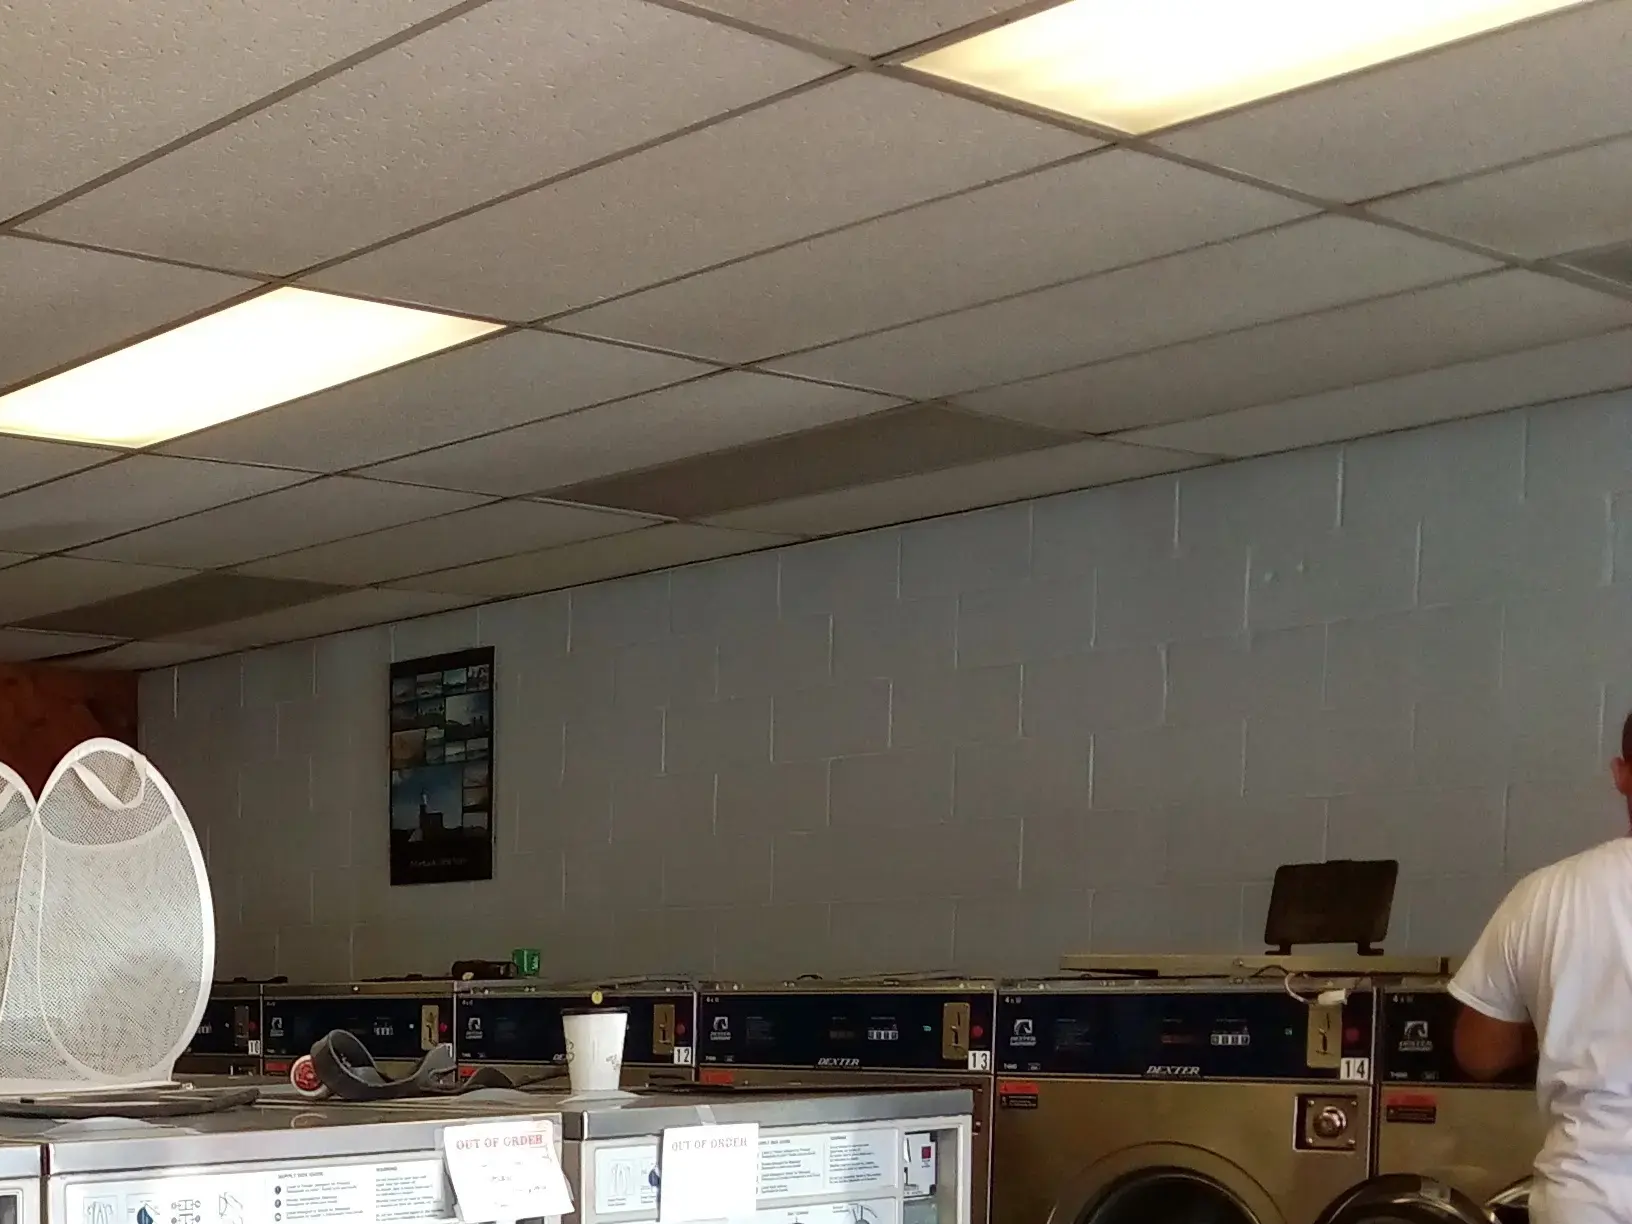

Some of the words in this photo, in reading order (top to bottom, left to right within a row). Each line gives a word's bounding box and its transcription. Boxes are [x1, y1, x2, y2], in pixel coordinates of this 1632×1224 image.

[676, 1047, 690, 1064] 12
[817, 1057, 860, 1066] DEXTER
[971, 1052, 989, 1069] 13
[1146, 1065, 1201, 1075] DEXTER
[1345, 1059, 1366, 1079] 14
[456, 1138, 480, 1151] OUT
[483, 1136, 500, 1148] OF
[671, 1140, 692, 1152] OUT
[694, 1138, 707, 1150] OF
[710, 1136, 748, 1149] ORDER
